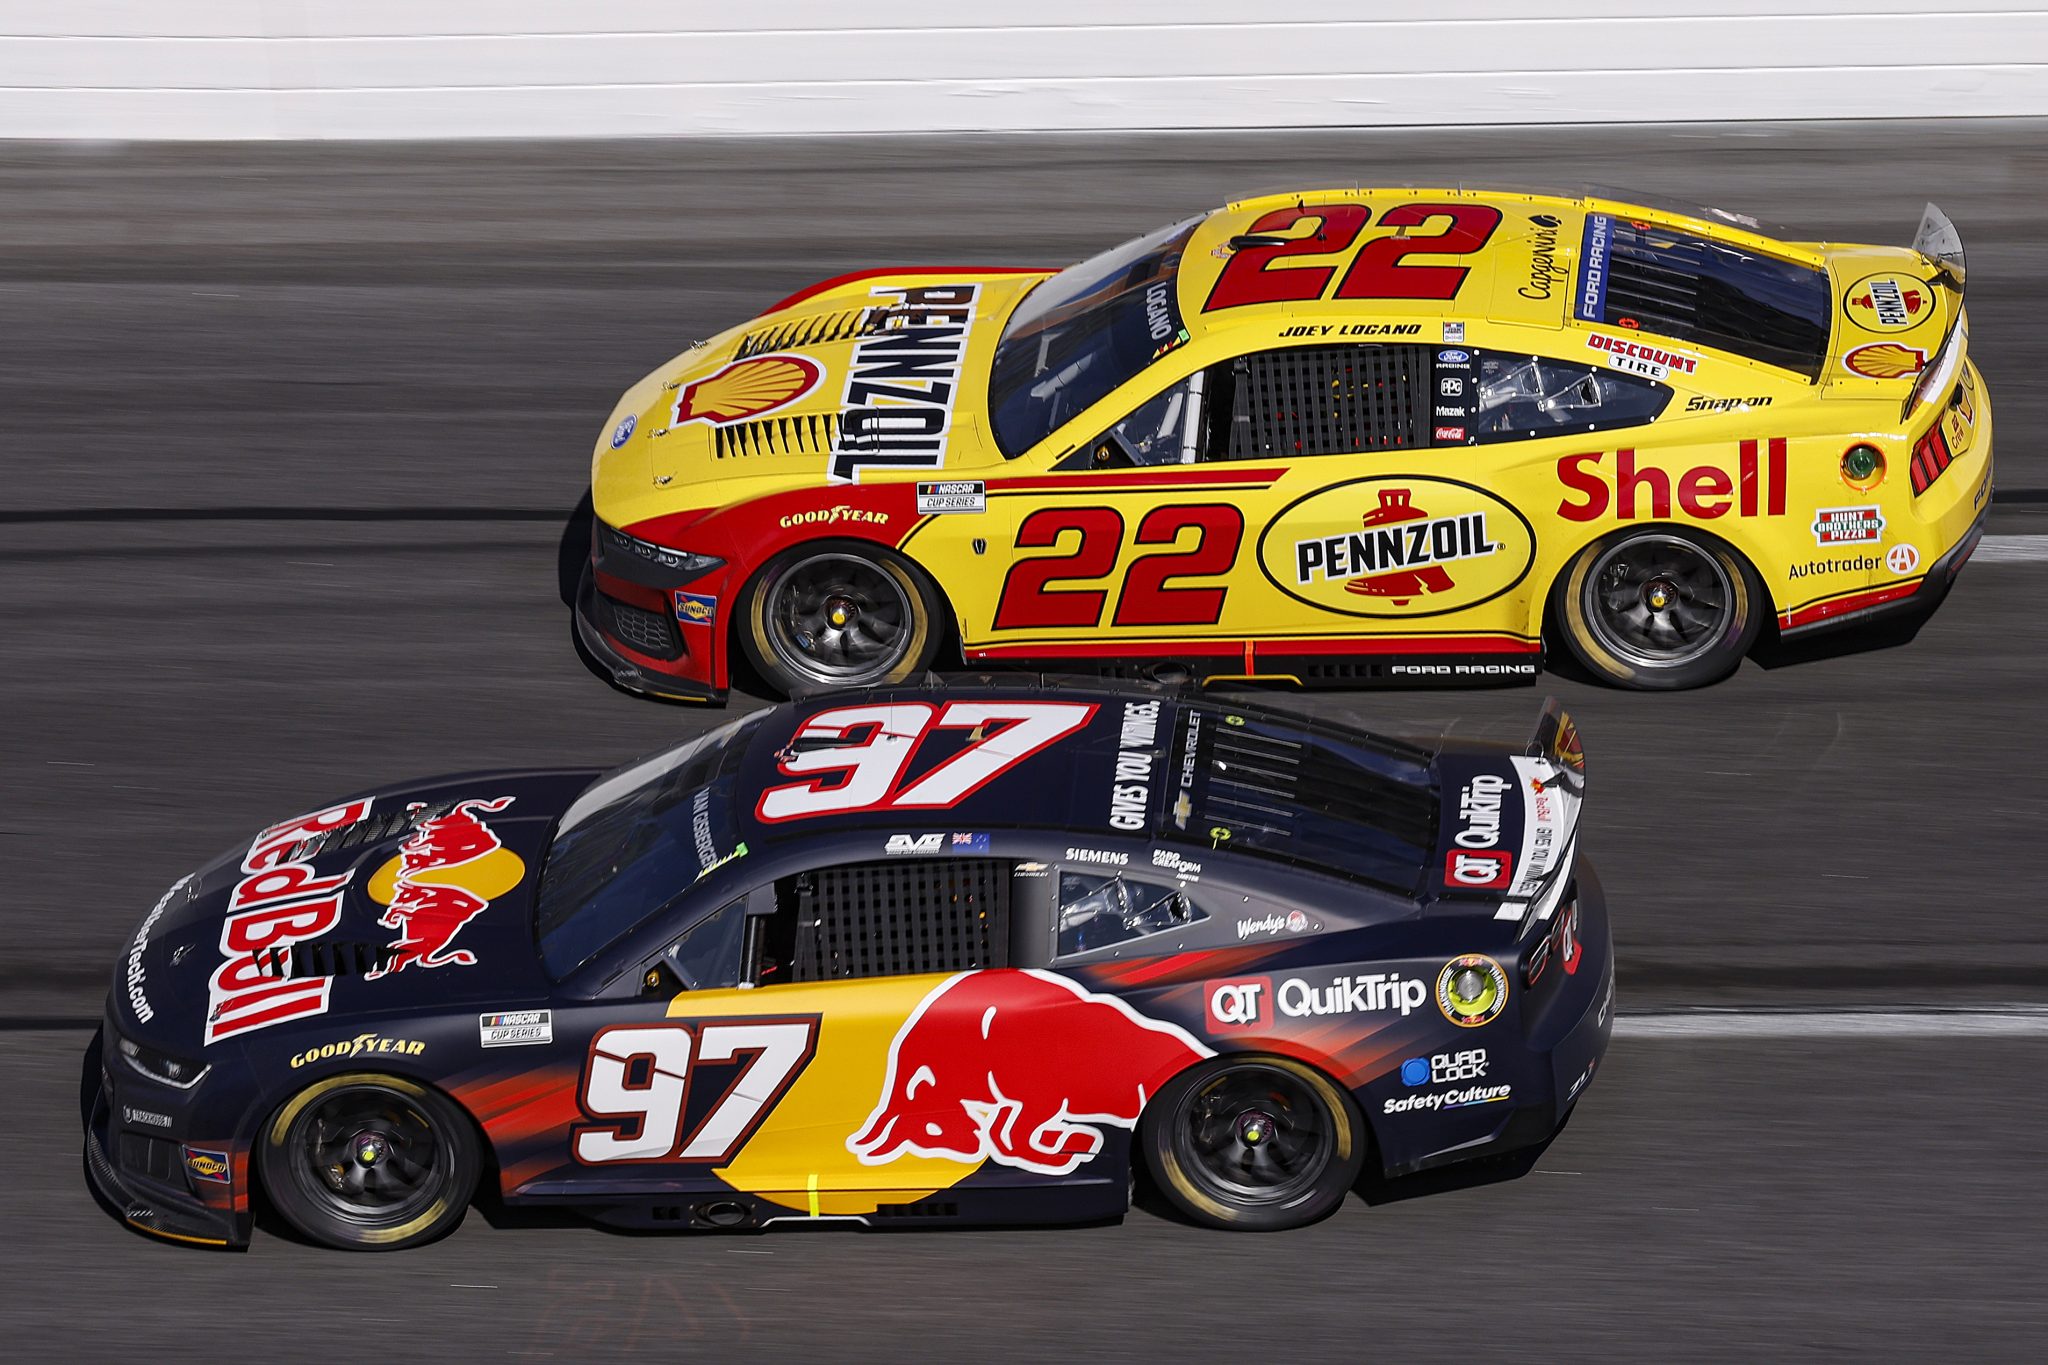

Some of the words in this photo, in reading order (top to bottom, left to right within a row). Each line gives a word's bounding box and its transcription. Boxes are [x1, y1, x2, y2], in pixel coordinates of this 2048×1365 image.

[1589, 215, 1606, 269] RACING
[1200, 203, 1503, 314] 22
[1518, 228, 1568, 300] Capgemini
[1582, 269, 1602, 318] FORD
[1869, 279, 1908, 325] PENNZOIL
[1146, 281, 1172, 340] LOGANO
[1279, 324, 1335, 337] JOEY
[1338, 324, 1422, 336] LOGANO
[1587, 334, 1697, 374] DISCOUNT
[1615, 357, 1662, 377] TIRE
[828, 284, 982, 485] PENNZOIL
[1442, 381, 1461, 395] PPG
[1436, 406, 1465, 417] Mazak
[1685, 395, 1773, 412] Snap-on
[938, 484, 975, 494] NASCAR
[1556, 437, 1787, 522] Shell
[780, 505, 889, 529] GOODYEAR
[927, 497, 945, 508] CUP
[945, 496, 976, 507] SERIES
[1830, 511, 1865, 523] HUNT
[1817, 519, 1879, 533] BROTHERS
[1831, 528, 1867, 540] PIZZA
[1296, 512, 1496, 584] PENNZOIL
[991, 503, 1245, 631] 22
[1788, 555, 1882, 580] Autotrader
[1391, 664, 1451, 674] FORD
[1455, 664, 1535, 674] RACING
[755, 701, 1100, 824] 97
[1180, 709, 1201, 788] CHEVROLET
[1115, 751, 1152, 782] YOU
[693, 787, 710, 815] VAN
[1109, 784, 1149, 830] GIVES
[1454, 774, 1513, 849] QuikTrip
[1065, 847, 1129, 865] SIEMENS
[1211, 983, 1262, 1024] QT
[1277, 973, 1427, 1017] QuikTrip
[490, 1029, 509, 1040] CUP
[510, 1027, 542, 1038] SERIES
[502, 1013, 542, 1024] NASCAR
[290, 1033, 426, 1069] GOODYEAR
[1431, 1048, 1486, 1070] QUAD
[1431, 1063, 1487, 1083] LOCK
[575, 1018, 817, 1166] 97
[1383, 1084, 1512, 1114] SafetyCulture
